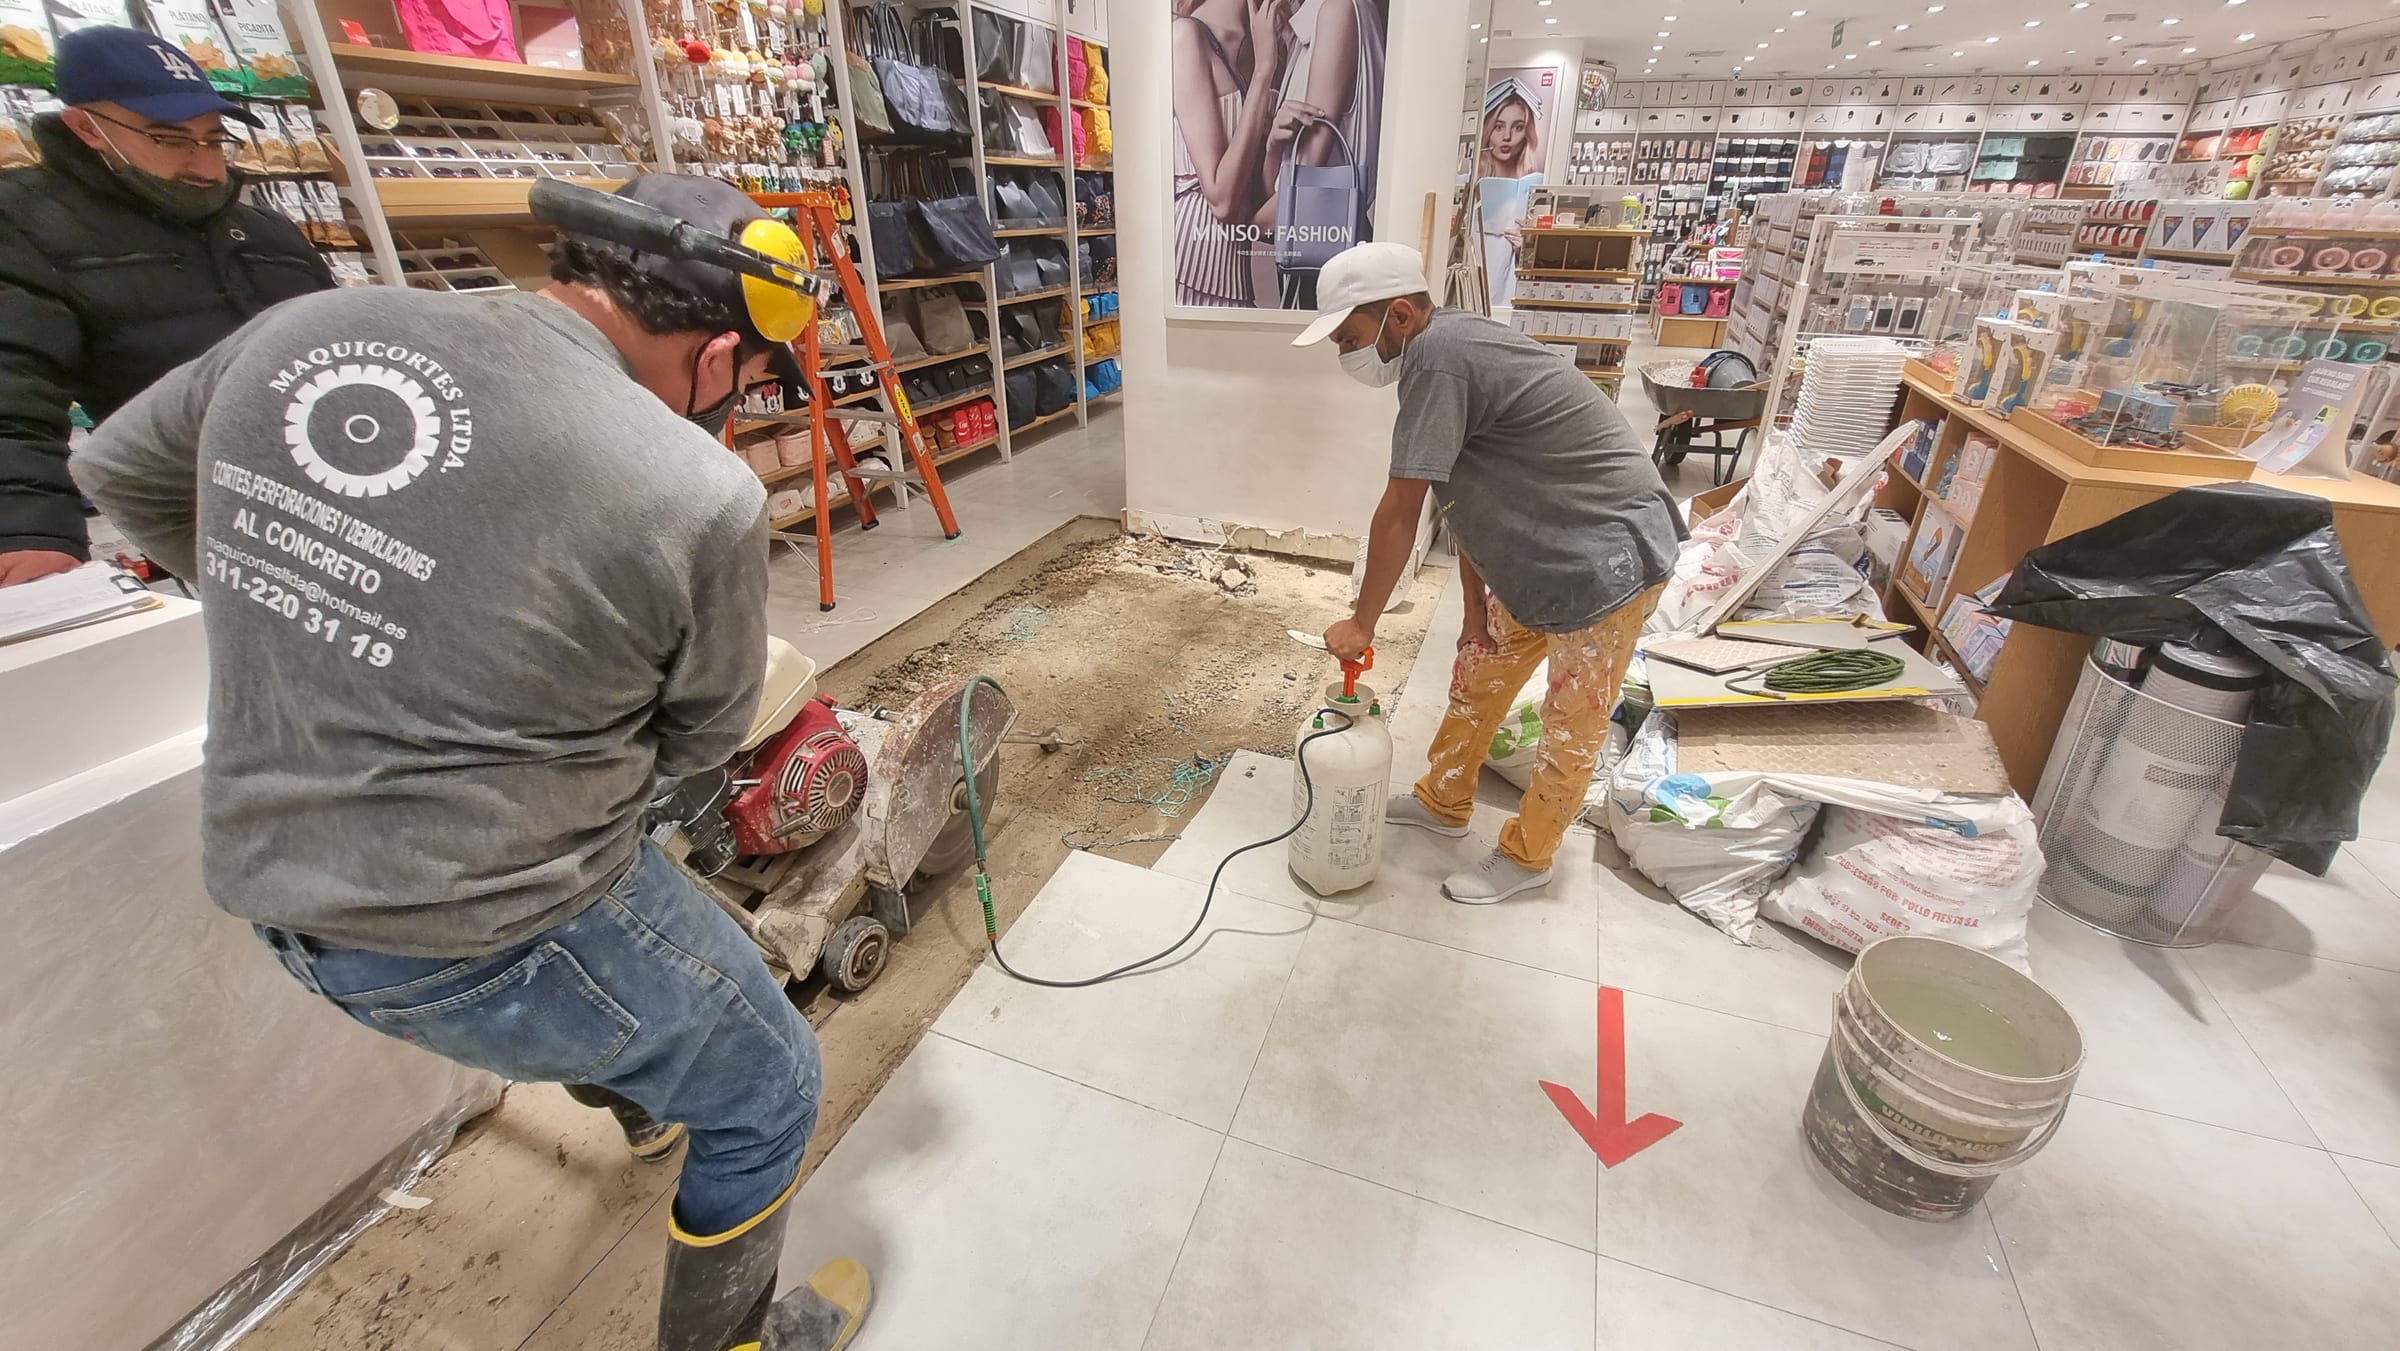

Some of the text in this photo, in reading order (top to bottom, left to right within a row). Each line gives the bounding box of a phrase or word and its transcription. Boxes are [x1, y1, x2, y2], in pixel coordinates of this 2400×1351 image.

[238, 22, 275, 34] PICADITA
[146, 44, 201, 82] LA
[1193, 224, 1260, 242] MINISO
[1277, 226, 1353, 243] FASHION
[269, 341, 472, 474] MAQUICORTES LTDA.
[233, 507, 382, 595] AL CONCRETO
[338, 513, 351, 538] Y
[345, 518, 436, 582] DEMOLICIONES
[206, 535, 408, 641] maquicortesltda@hotmail.es
[206, 551, 393, 668] 311-220 31 19
[1902, 898, 1931, 918] POLLO
[1932, 910, 1964, 926] FIESTA
